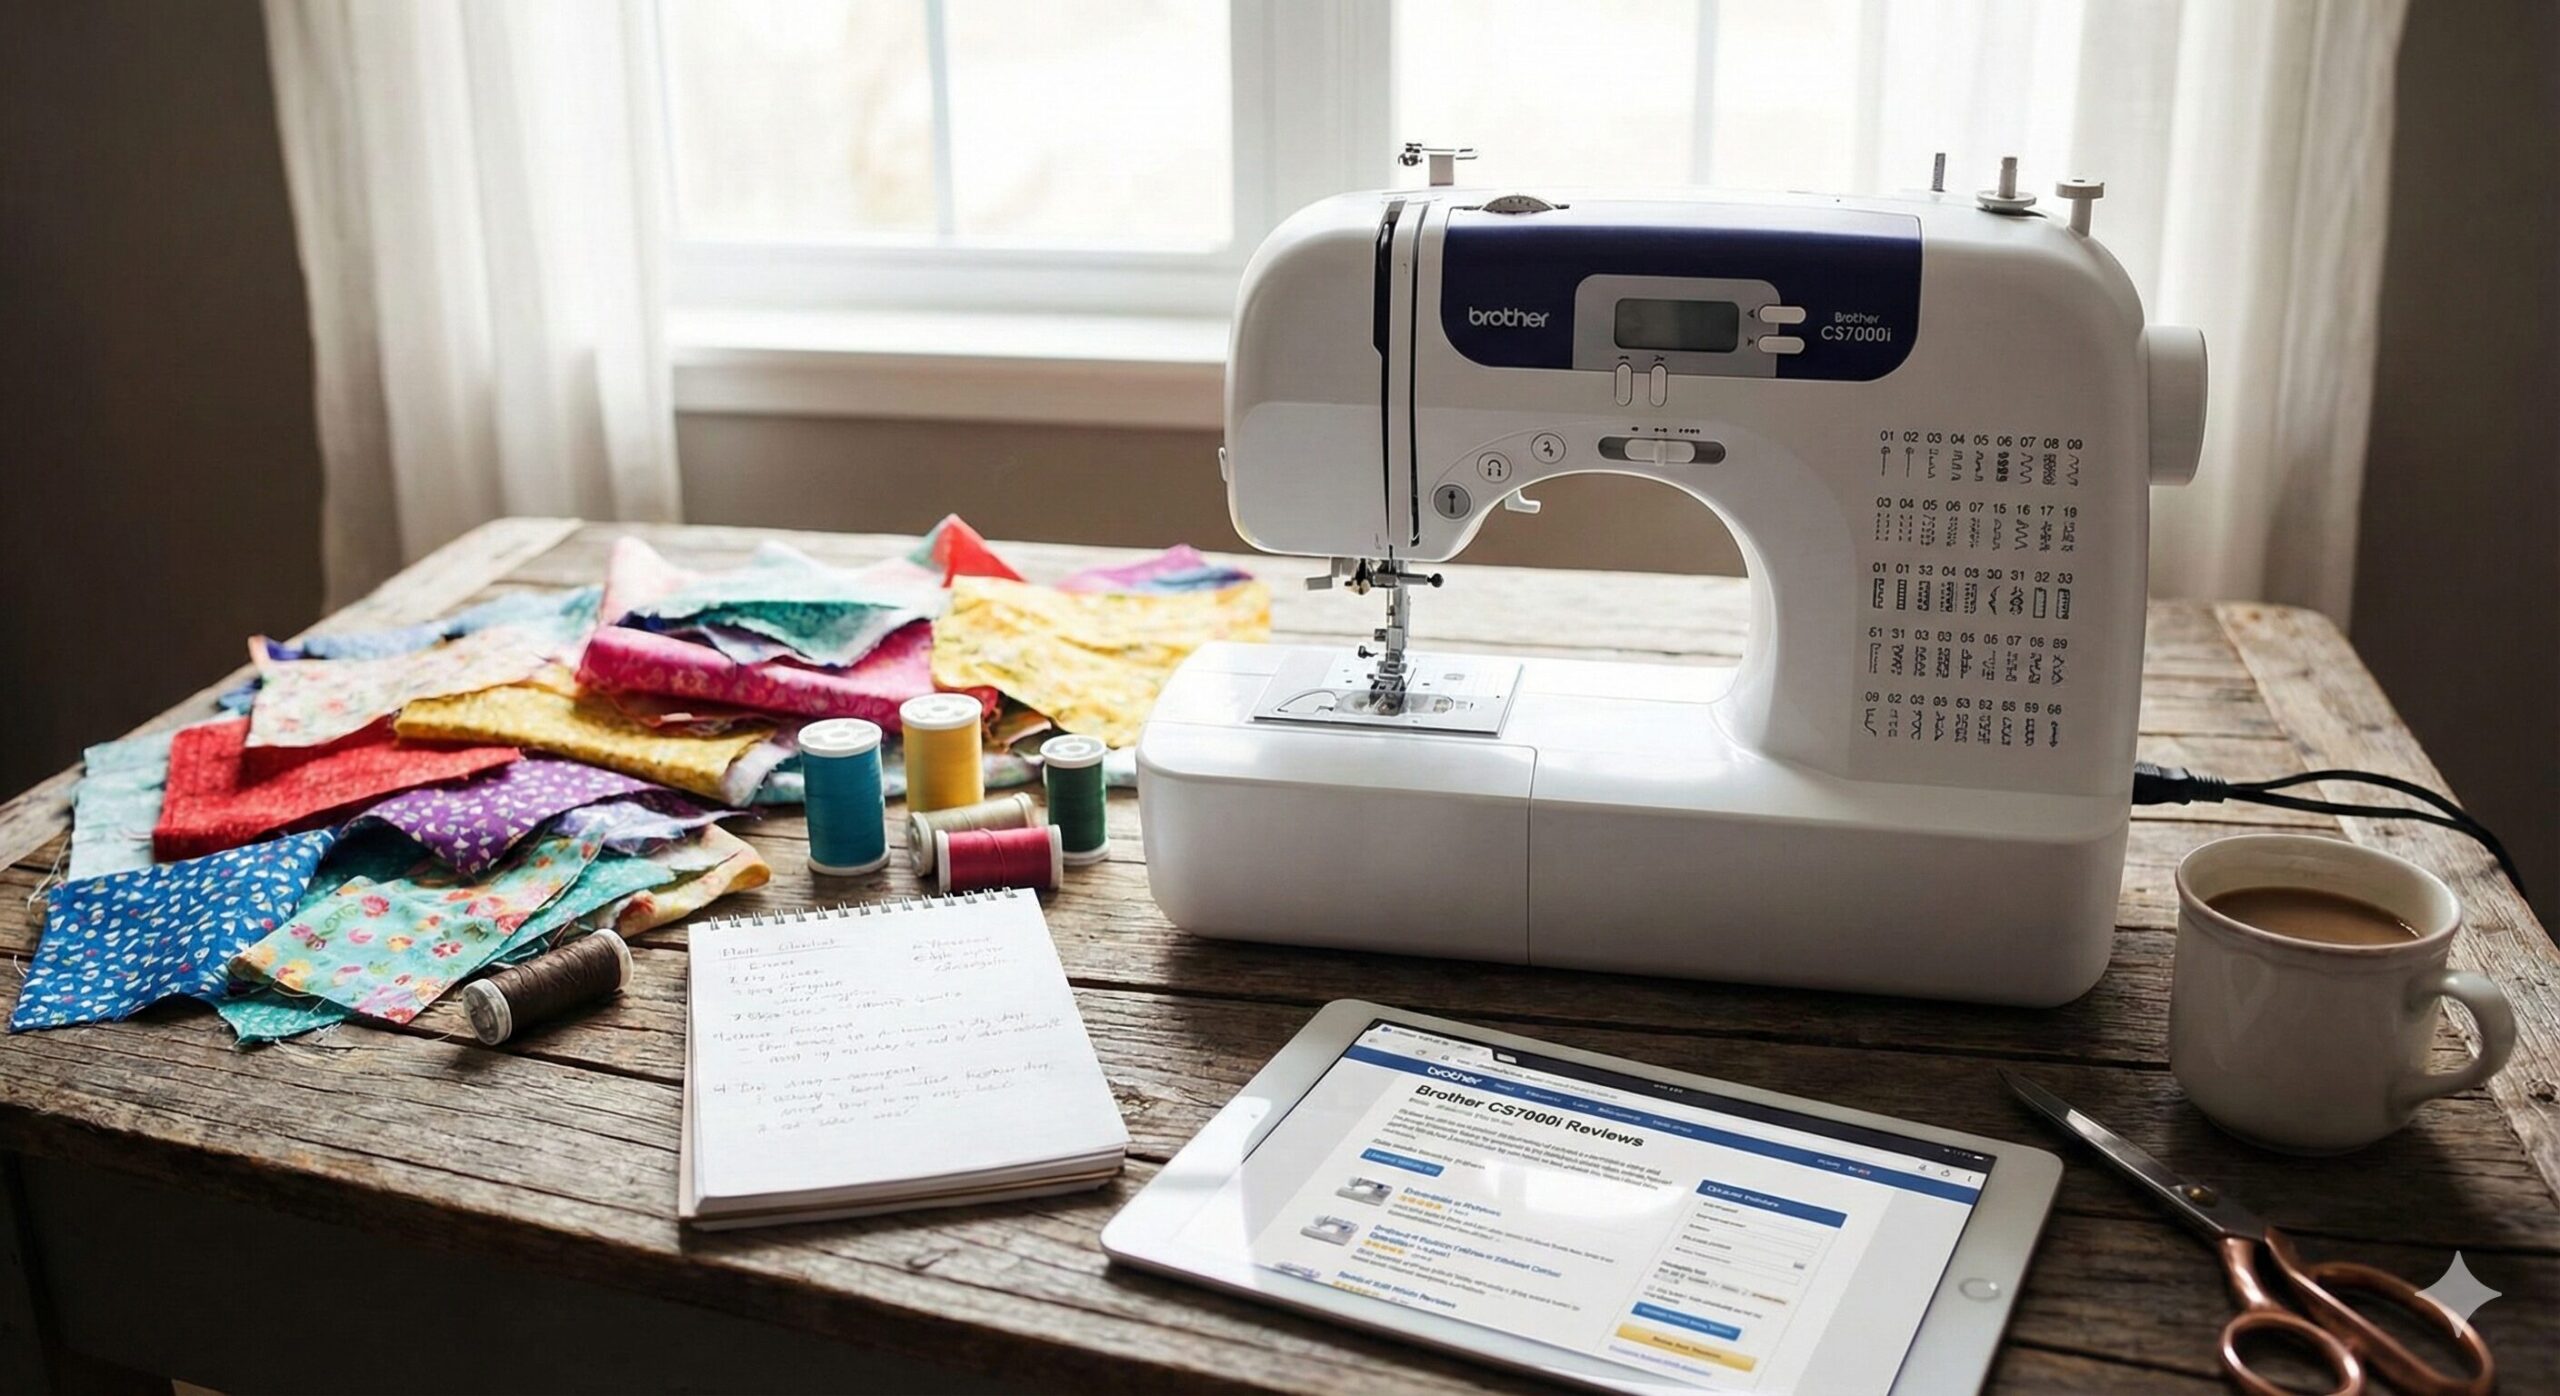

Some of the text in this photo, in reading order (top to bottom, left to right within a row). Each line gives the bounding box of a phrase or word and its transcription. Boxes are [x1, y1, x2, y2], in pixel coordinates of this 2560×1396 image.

[1468, 306, 1550, 330] brother
[1835, 312, 1881, 324] Brother
[1821, 326, 1892, 342] CS7000i
[1879, 430, 2084, 450] 01 02 03 04 05 06 07 08 09
[1899, 497, 1915, 510] 04
[1922, 499, 1938, 512] 05
[1945, 500, 1961, 512] 06
[1968, 501, 1985, 513] 07
[2016, 504, 2031, 516] 16
[2040, 504, 2055, 516] 17
[1872, 561, 1887, 573] 01
[1895, 562, 1910, 575] 01
[1941, 565, 1957, 577] 04
[1427, 1066, 1483, 1085] brother
[1415, 1084, 1485, 1109] Brother
[1487, 1101, 1564, 1128] CS7000i
[1565, 1119, 1645, 1147] Reviews
